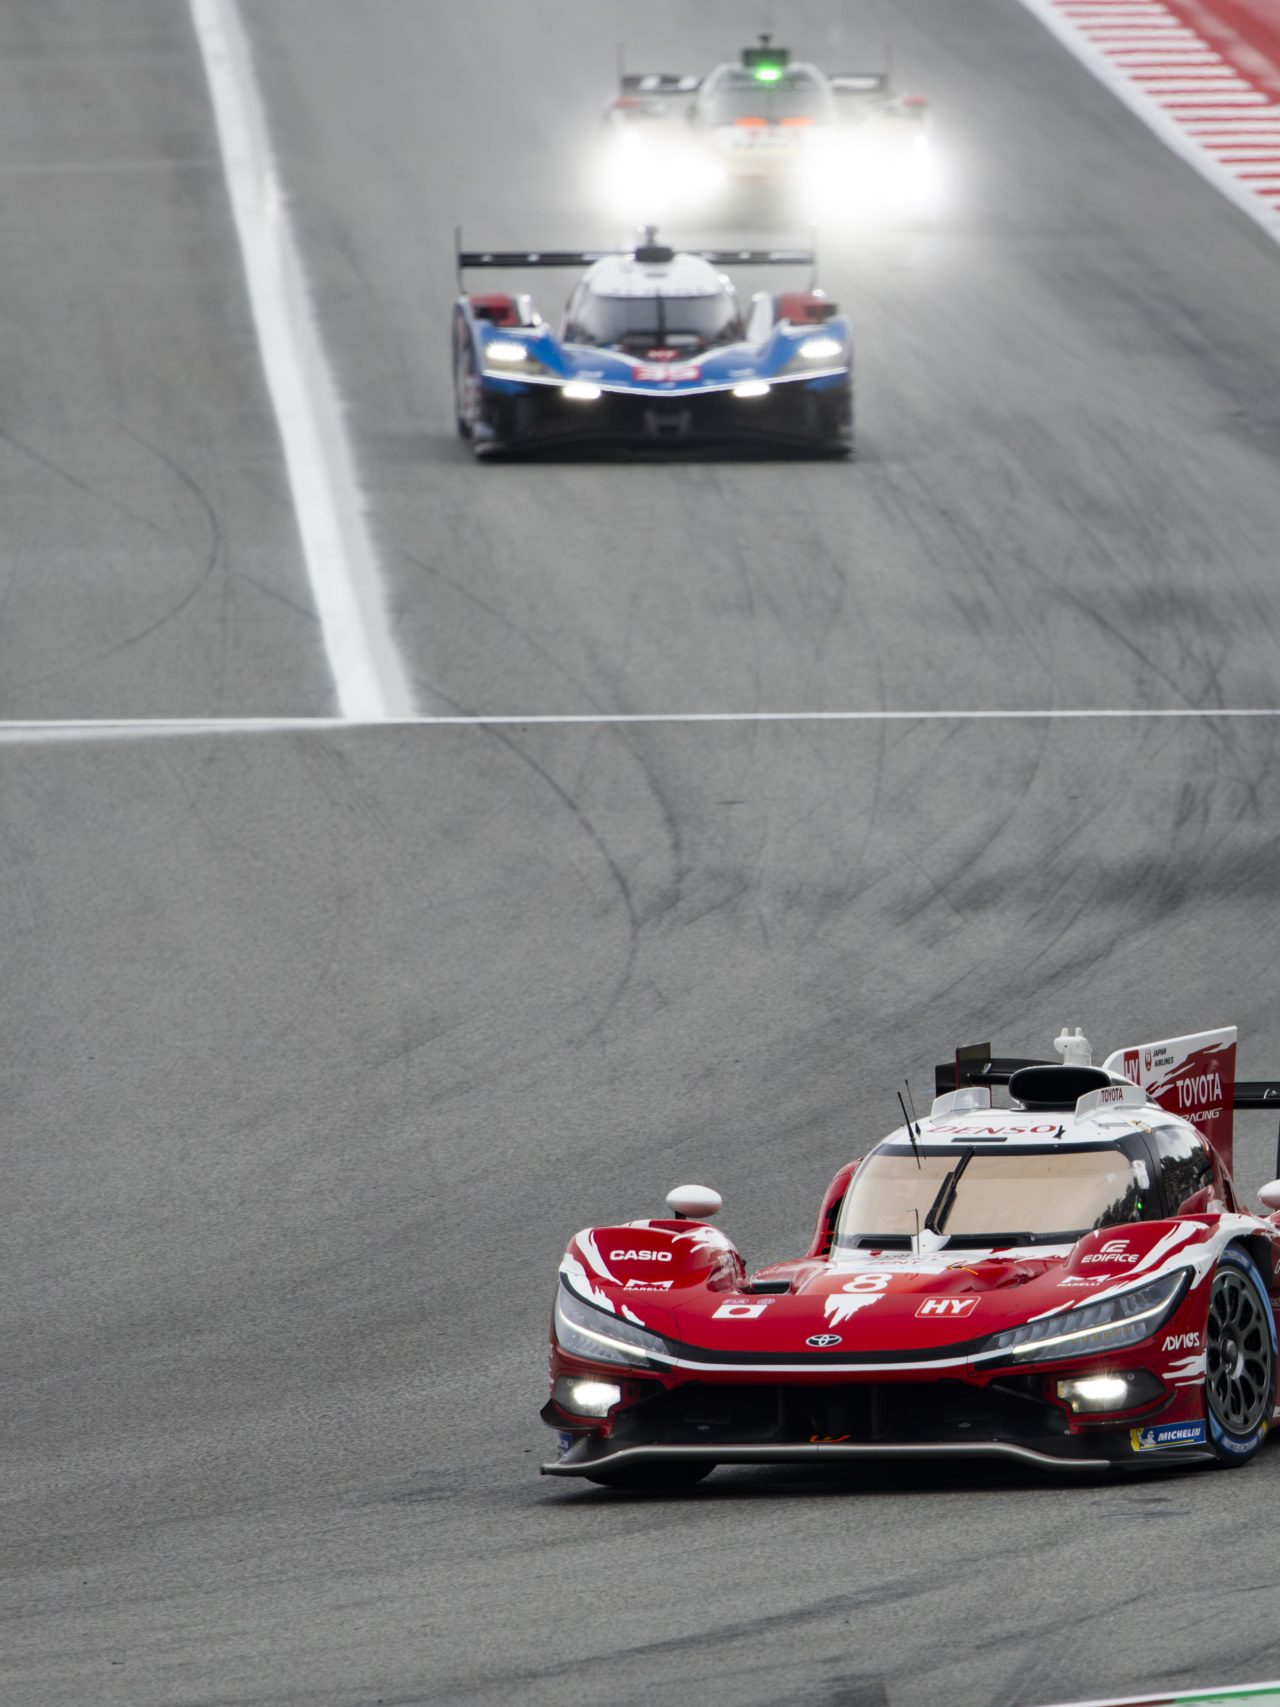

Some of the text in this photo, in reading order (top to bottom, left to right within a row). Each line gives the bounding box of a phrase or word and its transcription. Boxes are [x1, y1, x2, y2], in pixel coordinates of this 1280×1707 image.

[1153, 1048, 1167, 1057] JAPAN
[1154, 1056, 1174, 1067] AIRLINES
[1101, 1087, 1124, 1103] TOYOTA
[1176, 1072, 1222, 1108] TOYOTA
[927, 1125, 1056, 1135] DENSO
[610, 1249, 672, 1262] CASIO
[1081, 1253, 1140, 1264] EDIFICE
[841, 1273, 893, 1293] 8
[920, 1298, 976, 1315] HY
[1161, 1331, 1200, 1352] ADVICS
[1157, 1427, 1202, 1442] MICHELIN
